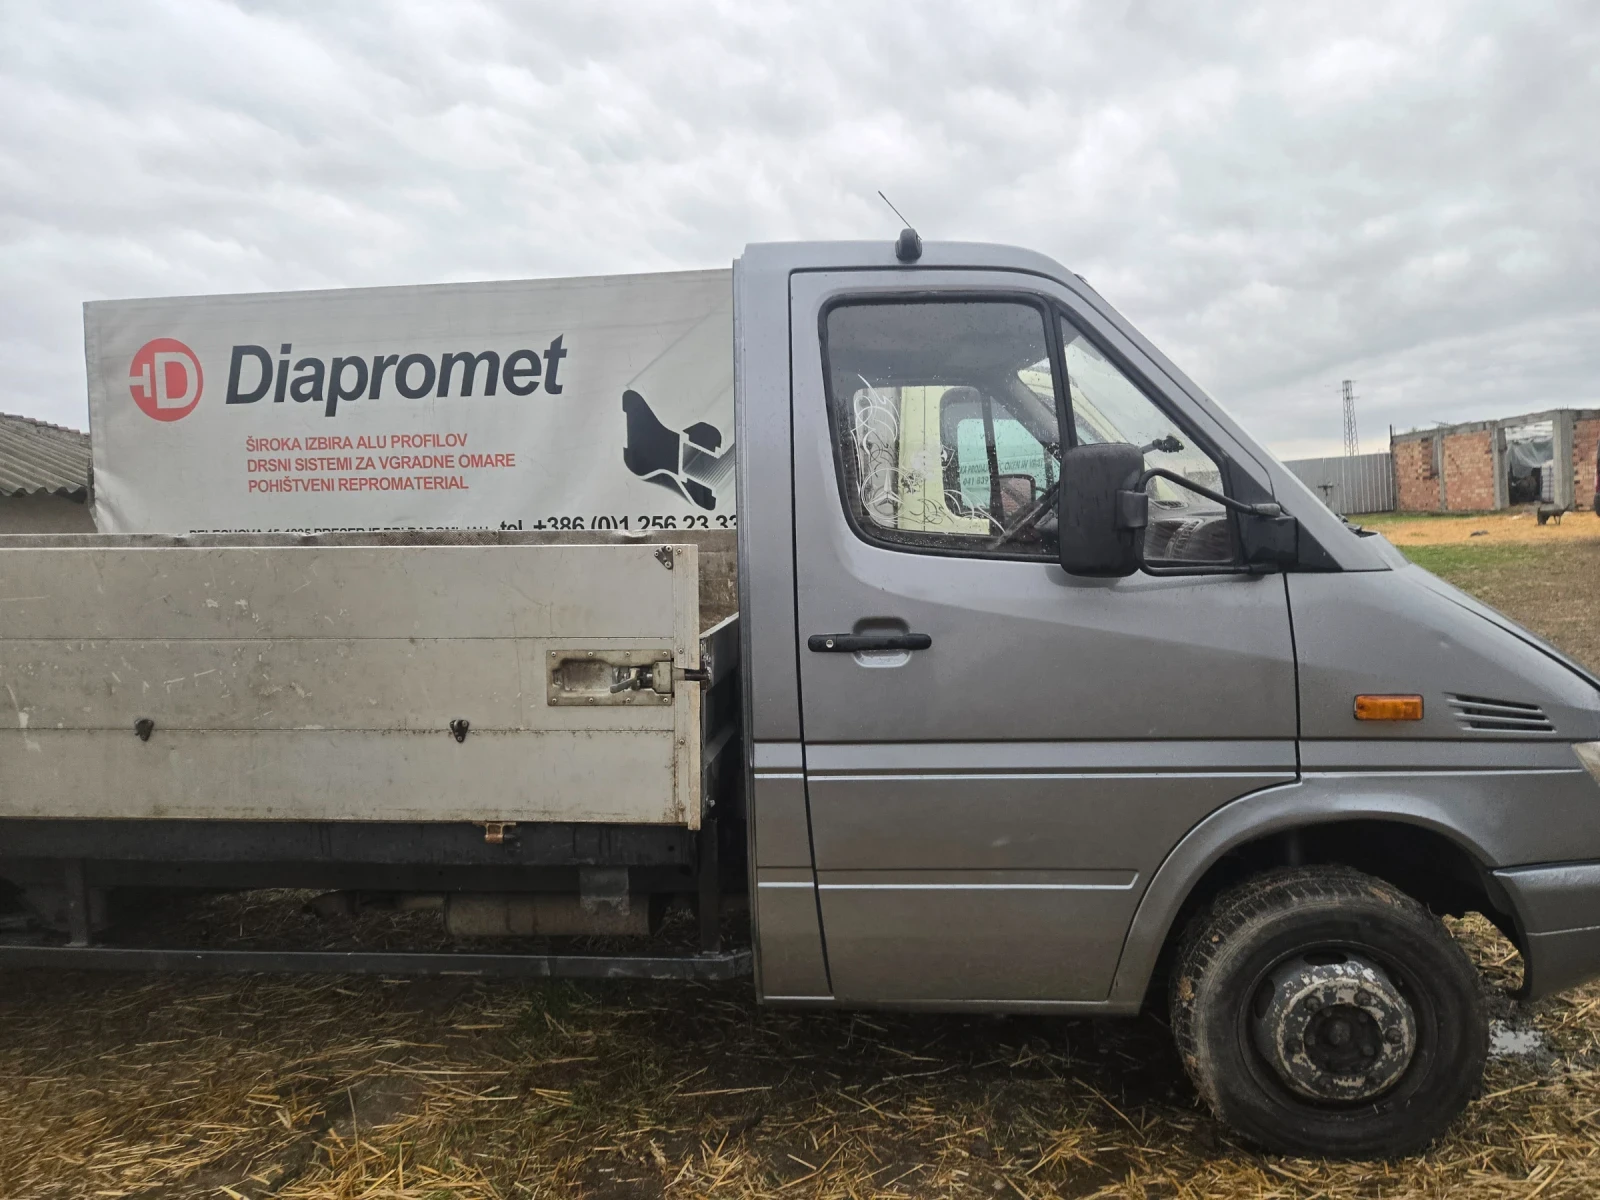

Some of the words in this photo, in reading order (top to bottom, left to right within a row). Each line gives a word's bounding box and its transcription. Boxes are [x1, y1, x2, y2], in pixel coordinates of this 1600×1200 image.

[225, 333, 568, 418] Diapromet
[246, 435, 302, 452] ŠIROKA
[305, 436, 353, 451] IZBIRA
[356, 435, 387, 450] ALU
[391, 433, 468, 449] PROFILOV
[247, 458, 292, 473] DRSNI
[295, 456, 353, 472] SISTEMI
[355, 455, 376, 470] ZA
[379, 454, 455, 470] VGRADNE
[458, 453, 516, 468] OMARE
[248, 475, 335, 493] POHIŠTVENI
[338, 475, 469, 491] REPROMATERIAL
[533, 516, 585, 530] +386
[637, 515, 677, 529] 256
